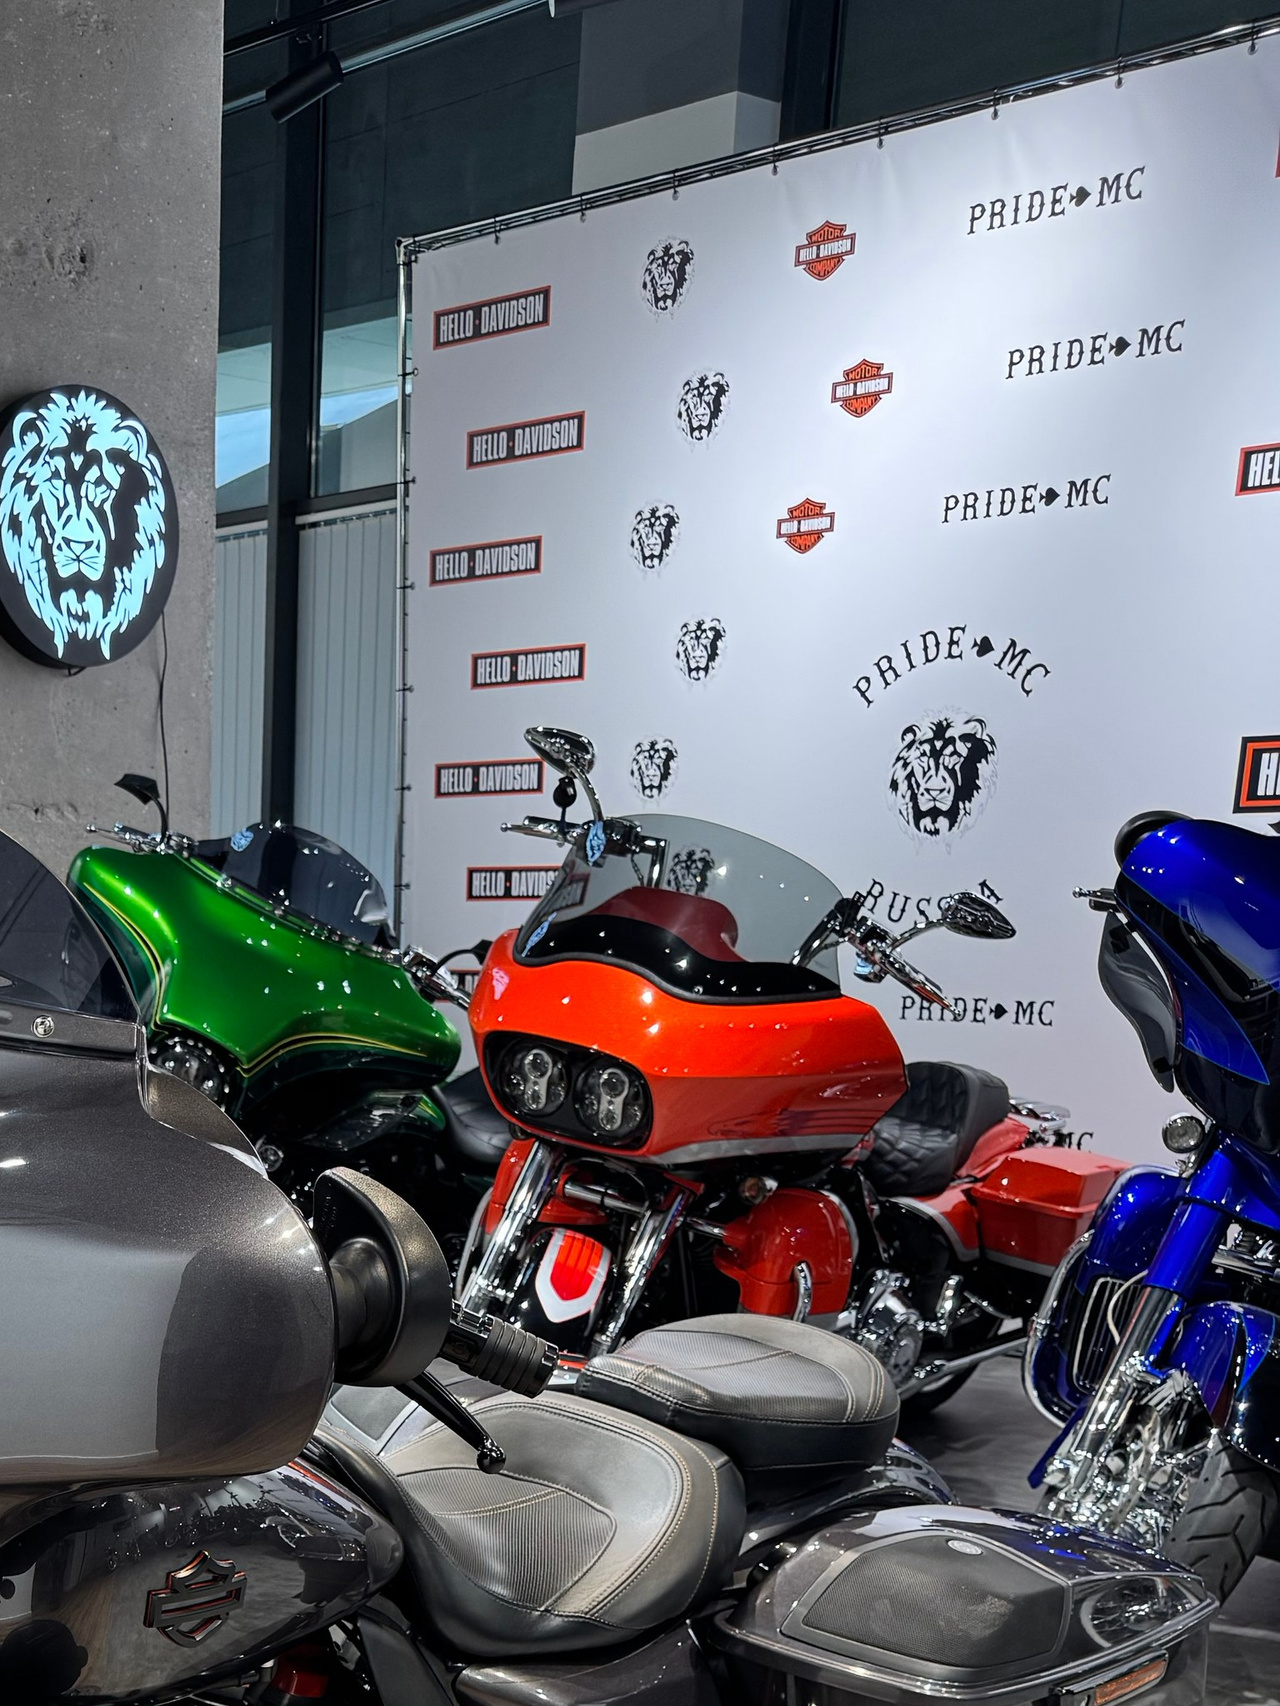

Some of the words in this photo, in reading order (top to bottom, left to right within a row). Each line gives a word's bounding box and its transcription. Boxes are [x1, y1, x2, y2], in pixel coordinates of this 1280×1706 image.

[966, 182, 1069, 236] PRIDE
[1095, 165, 1146, 208] MC
[811, 226, 841, 243] MOTOR
[439, 309, 474, 343] HELLO
[480, 293, 545, 335] DAVIDSON
[1005, 332, 1109, 380] PRIDE
[1135, 319, 1186, 358] MC
[848, 364, 878, 380] MOTOR
[472, 430, 507, 464] HELLO
[514, 418, 579, 457] DAVIDSON
[1247, 450, 1280, 488] HEL
[941, 482, 1039, 524] PRIDE
[1064, 473, 1112, 509] MC
[435, 551, 469, 581] HELLO
[474, 542, 537, 576] DAVIDSON
[476, 655, 511, 685] HELLO
[517, 649, 580, 682] DAVIDSON
[852, 624, 968, 709] PRIDE
[993, 637, 1052, 698] MC
[439, 767, 473, 794] HELLO
[478, 763, 539, 792] DAVIDSON
[471, 871, 506, 897] HELLO
[1011, 999, 1056, 1028] MC
